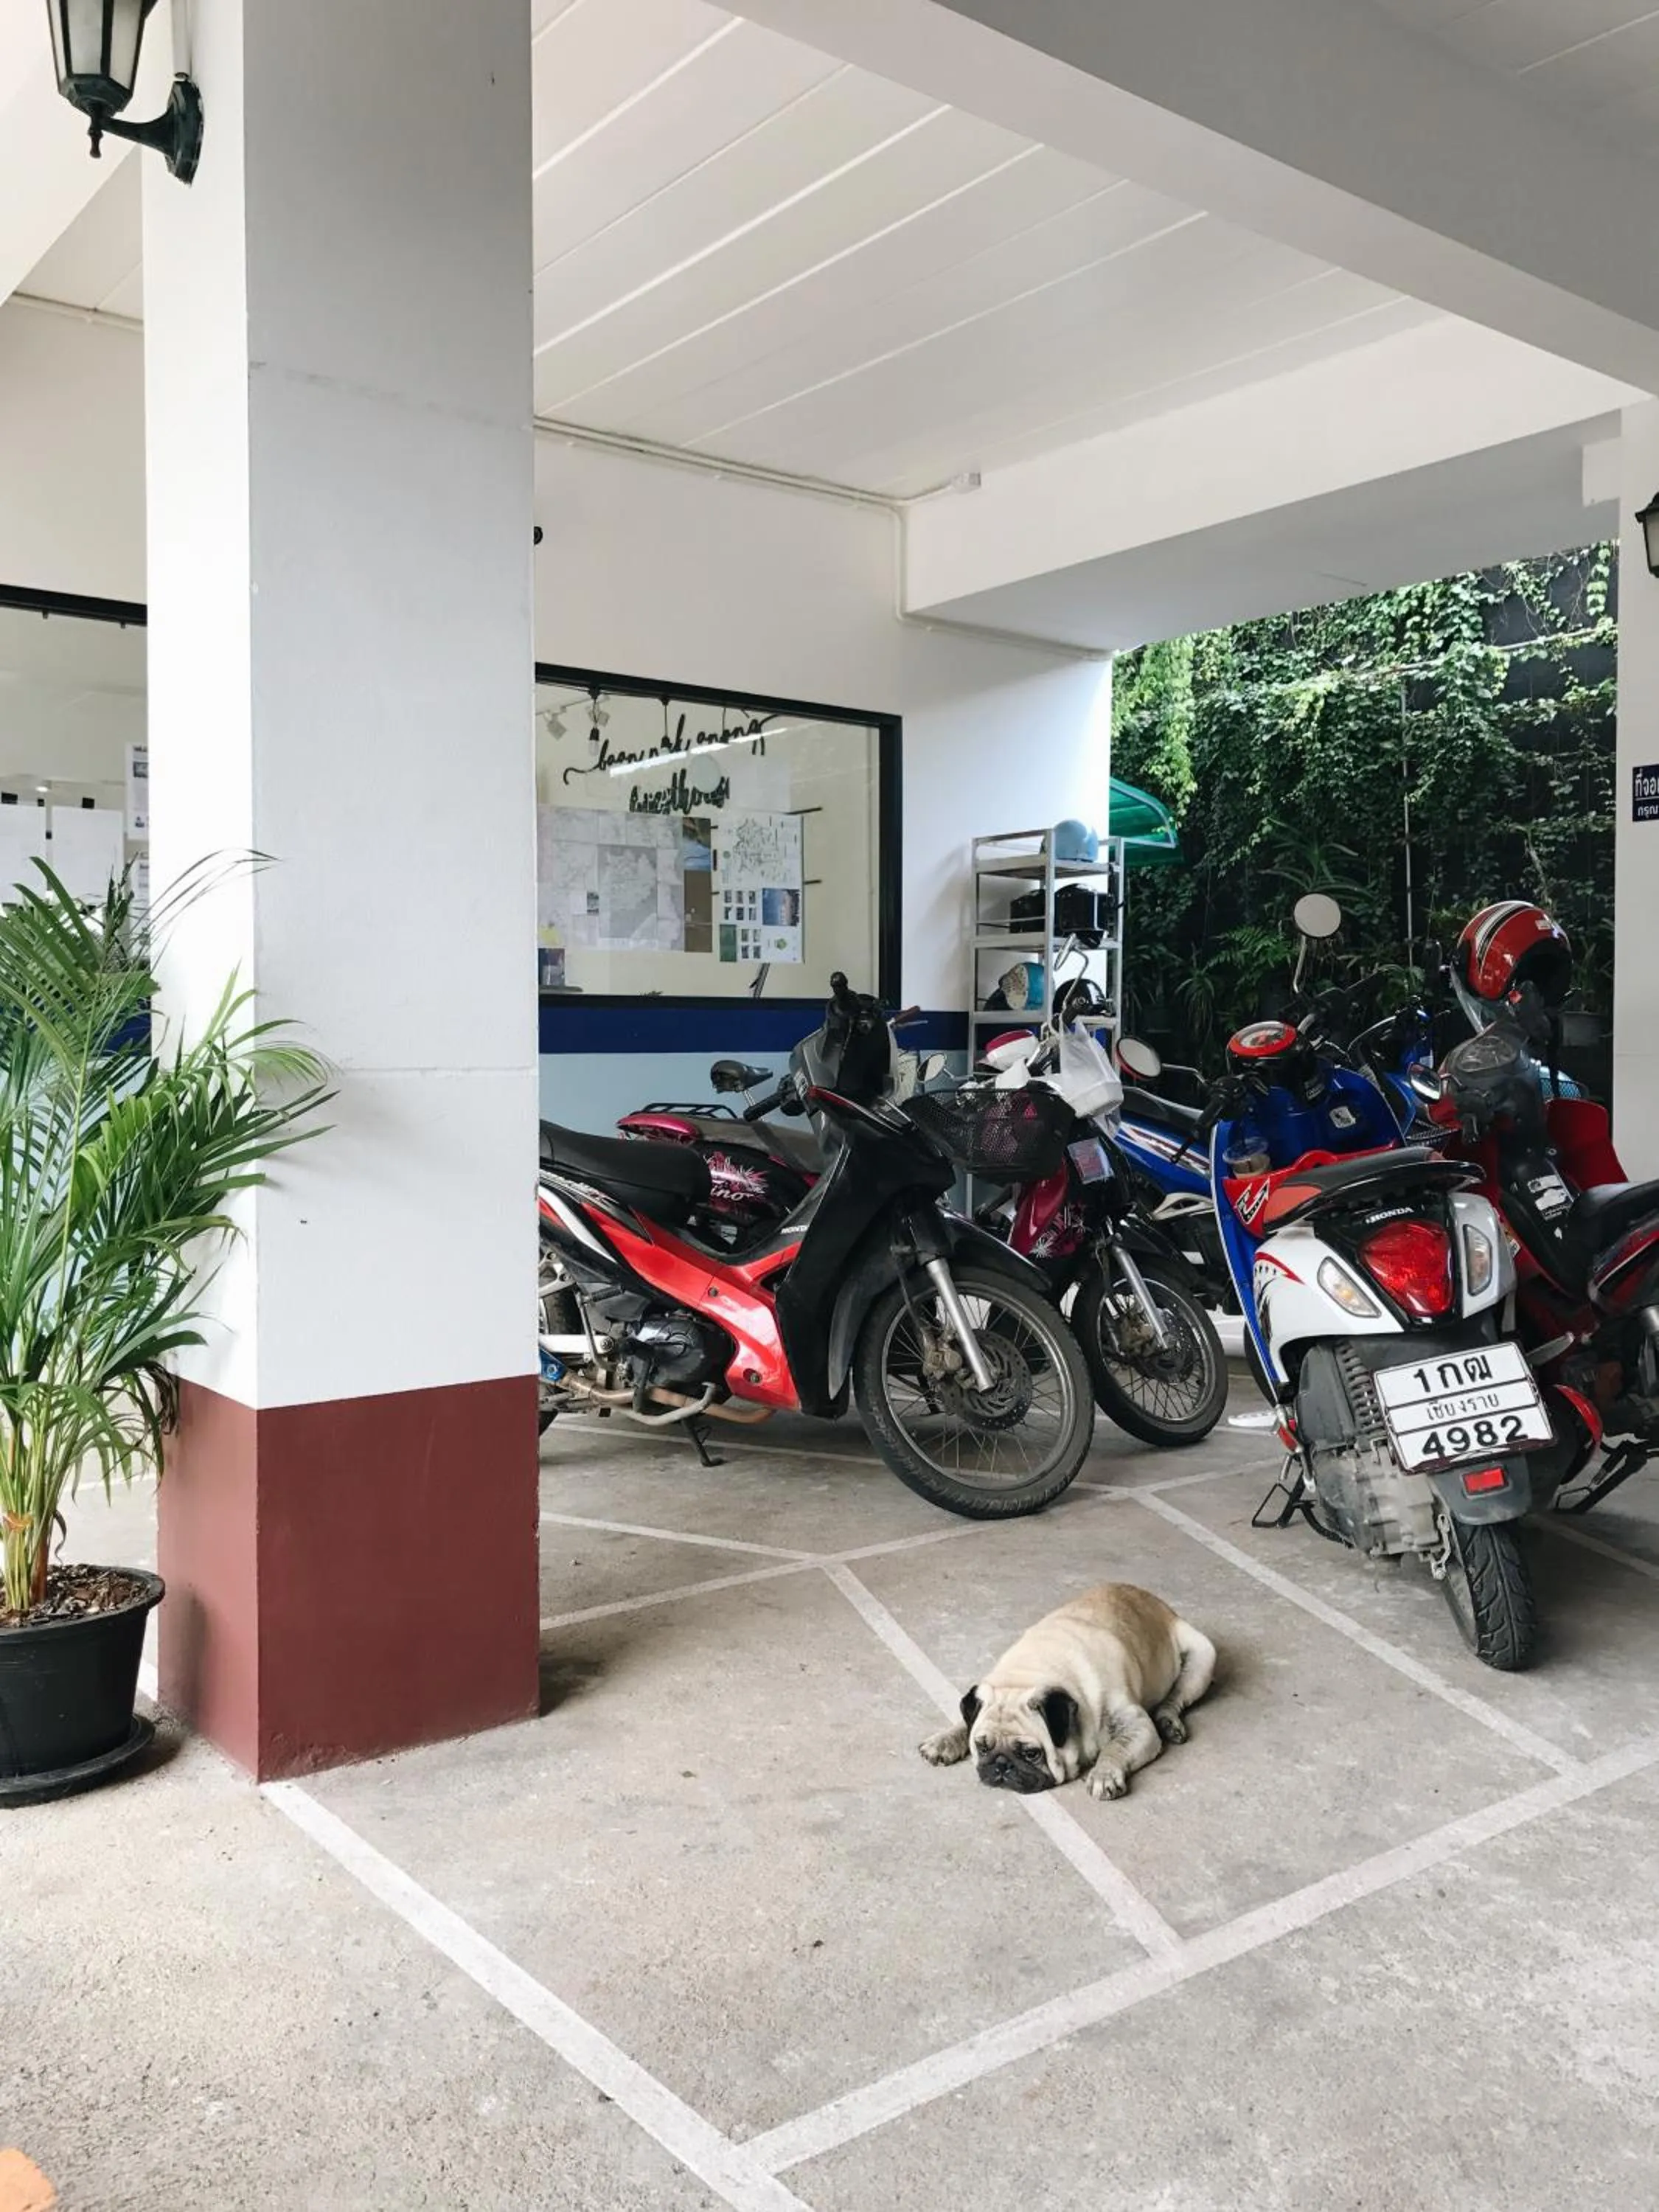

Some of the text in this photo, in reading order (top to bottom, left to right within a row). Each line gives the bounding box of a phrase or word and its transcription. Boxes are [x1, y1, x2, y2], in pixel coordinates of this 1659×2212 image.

[1635, 768, 1659, 797] ที่จอ
[1366, 1206, 1414, 1224] HONDA
[1426, 1393, 1500, 1421] เชียงราย
[1422, 1415, 1528, 1458] 4982
